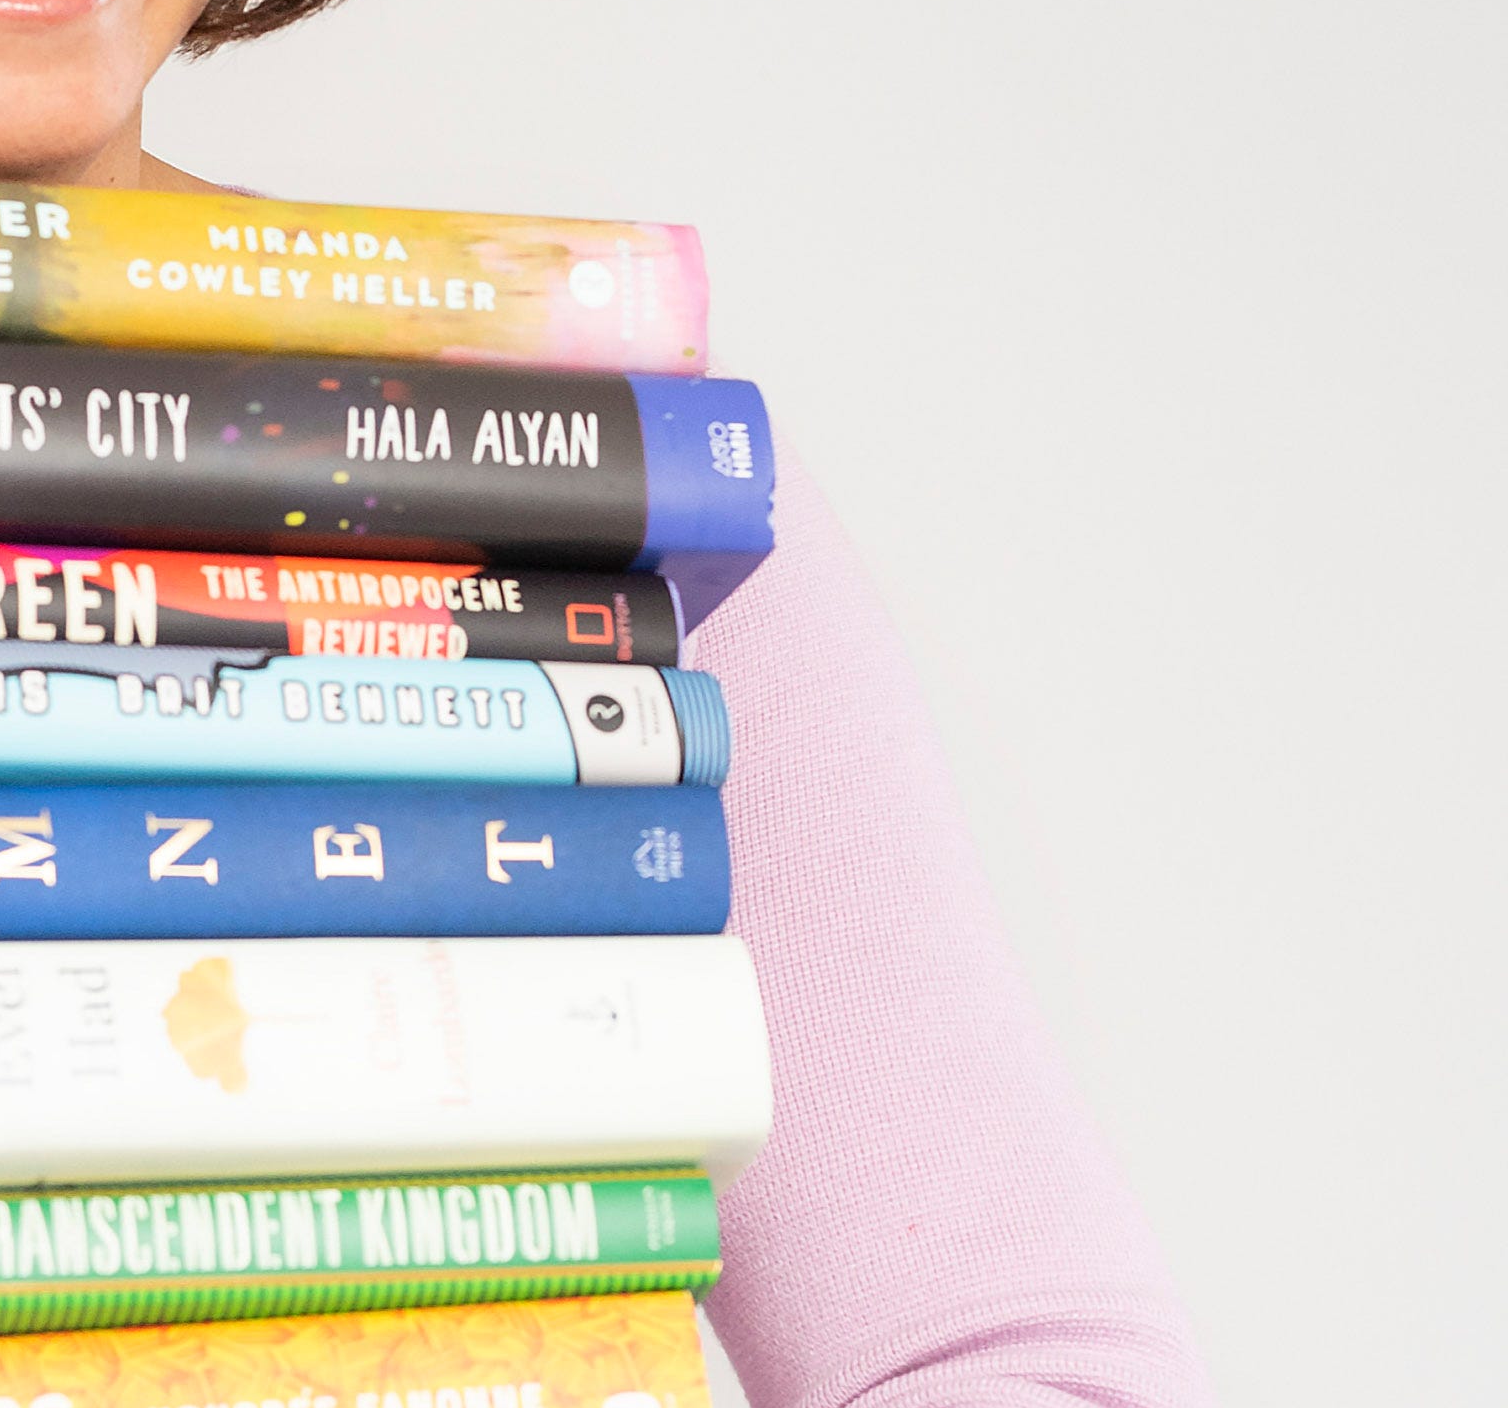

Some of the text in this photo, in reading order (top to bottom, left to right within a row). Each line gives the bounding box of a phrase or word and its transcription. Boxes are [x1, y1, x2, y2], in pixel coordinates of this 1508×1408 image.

[207, 224, 409, 263] MIRANDA
[126, 258, 496, 312] COWLEY HELLER
[85, 387, 191, 463] CITY
[345, 403, 599, 469] HALA ALYAN
[199, 564, 525, 614] THE ANTHROPOCENE
[302, 617, 470, 662] REVIEWED
[280, 679, 526, 730] BENNETT
[57, 963, 123, 1081] Had
[357, 1181, 599, 1270] KINGDOM
